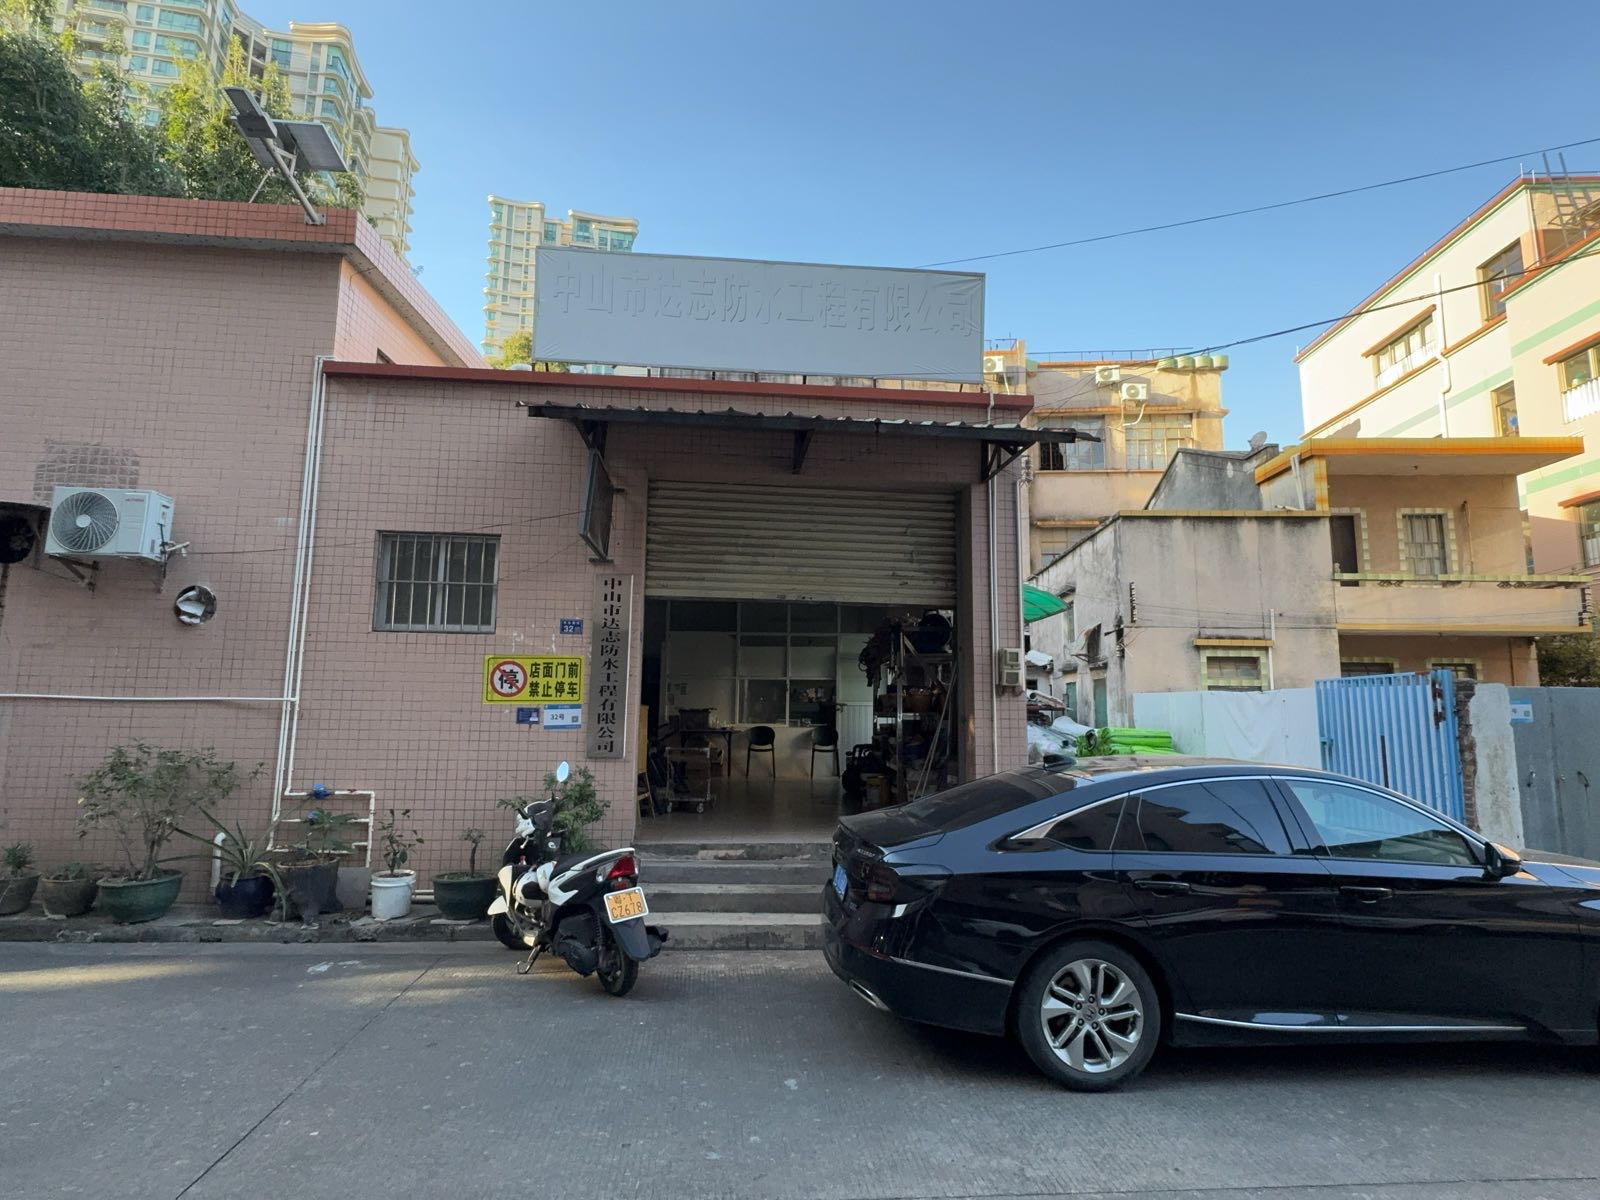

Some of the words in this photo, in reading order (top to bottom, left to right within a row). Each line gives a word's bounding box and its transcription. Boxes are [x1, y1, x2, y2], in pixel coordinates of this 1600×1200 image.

[552, 262, 974, 338] 中山市达志防水工程有限公司
[563, 625, 575, 633] 32
[529, 662, 579, 678] 店面门前
[597, 577, 621, 753] 中山市达志防水工程有限公司
[498, 669, 519, 690] 停
[528, 681, 578, 698] 禁止停车
